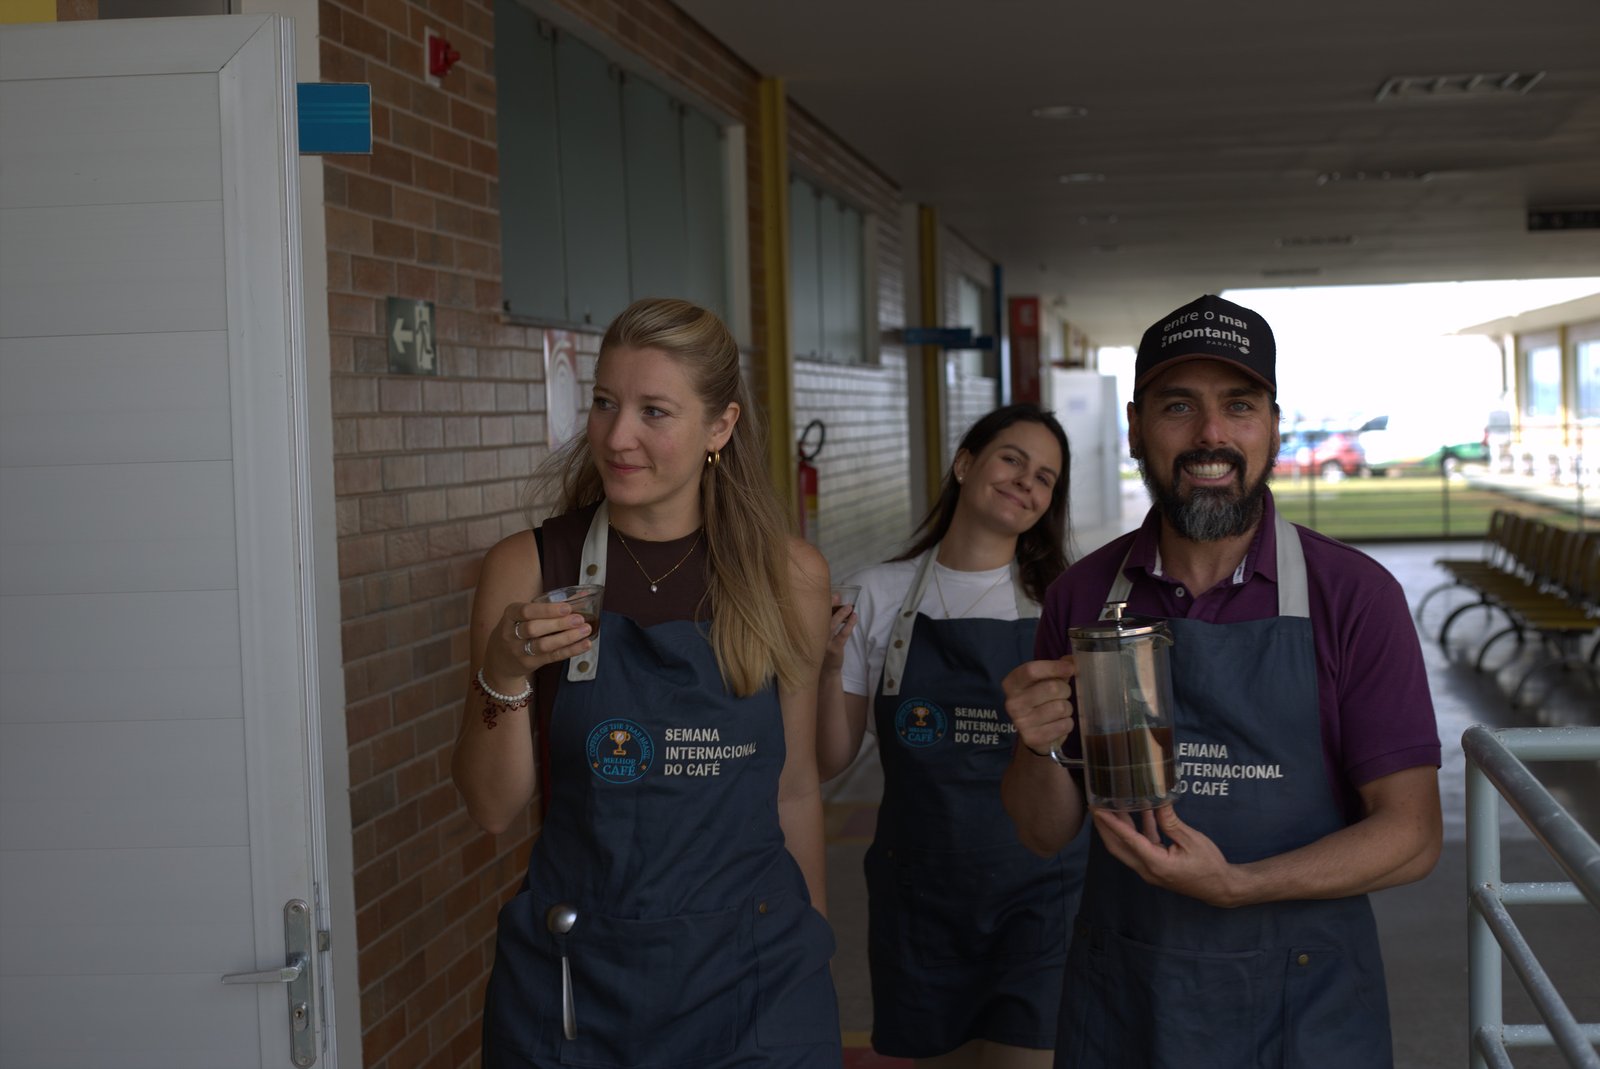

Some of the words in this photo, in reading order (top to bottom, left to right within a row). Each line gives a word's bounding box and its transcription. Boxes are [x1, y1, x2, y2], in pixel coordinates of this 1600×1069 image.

[1163, 311, 1199, 332] entre
[1168, 326, 1250, 347] montanha
[954, 707, 998, 720] SEMANA
[665, 728, 720, 742] SEMANA
[955, 732, 969, 743] DO
[972, 733, 999, 745] CAFÉ
[665, 742, 757, 760] INTERNACIONAL
[1178, 742, 1228, 759] EMANA
[664, 763, 683, 776] DO
[686, 760, 720, 776] CAFÉ
[1192, 779, 1229, 796] CAFÉ
